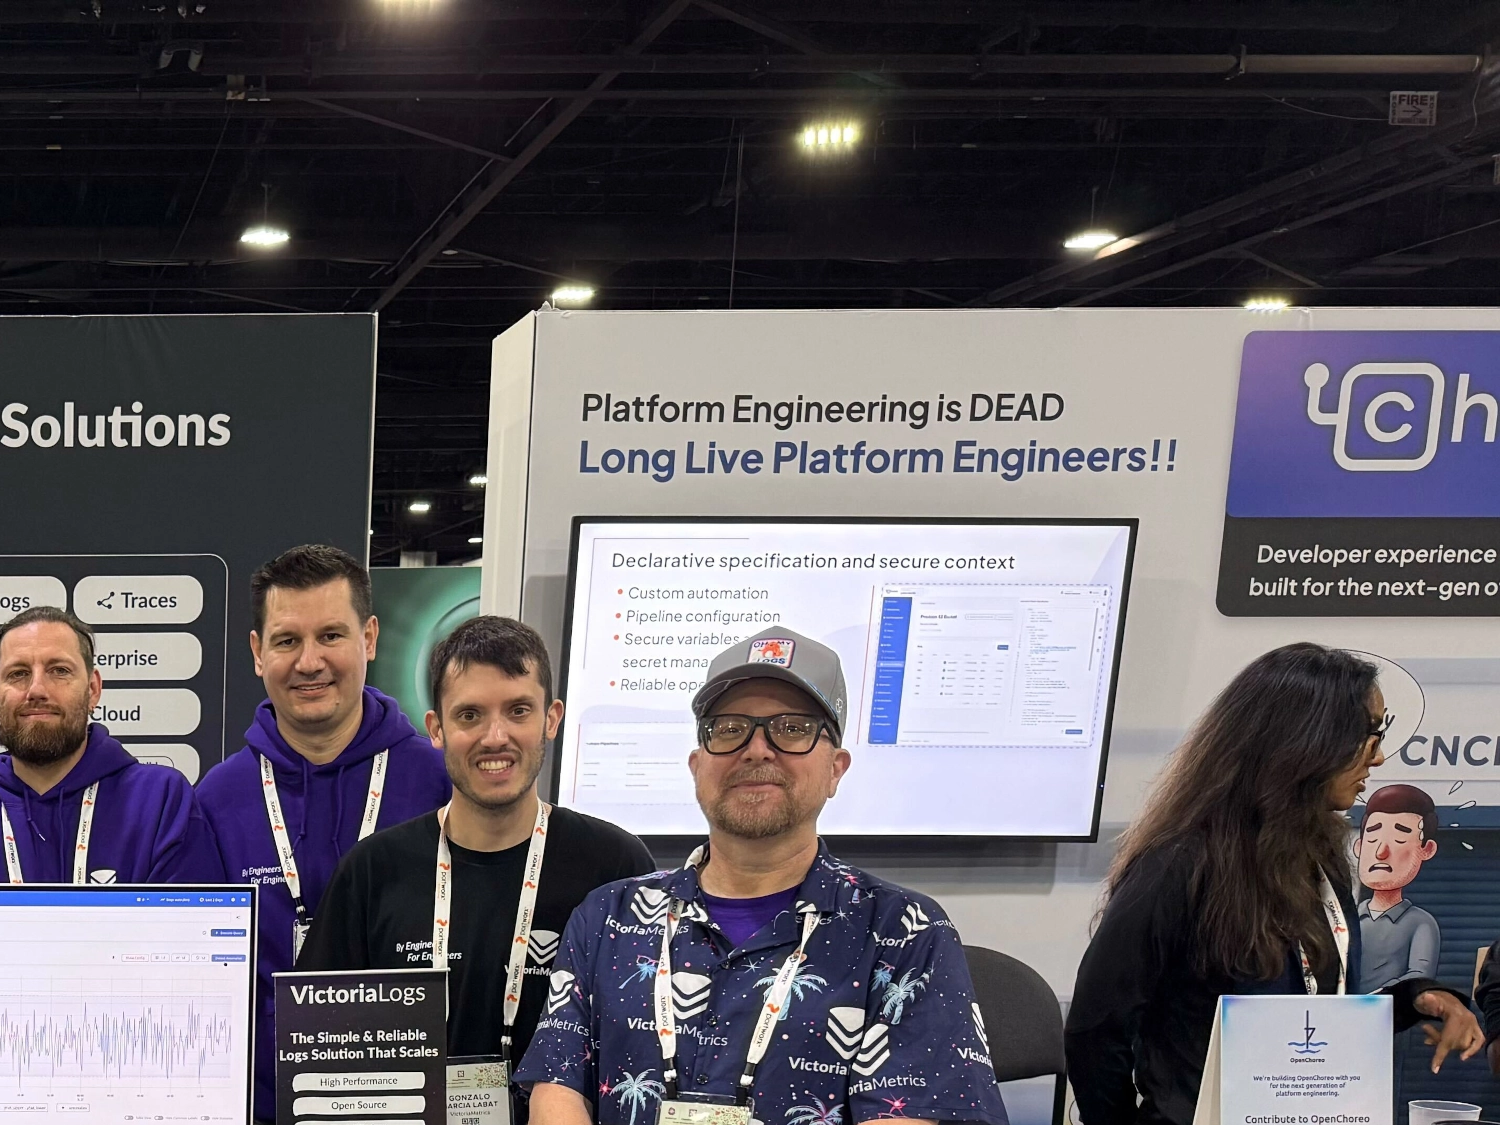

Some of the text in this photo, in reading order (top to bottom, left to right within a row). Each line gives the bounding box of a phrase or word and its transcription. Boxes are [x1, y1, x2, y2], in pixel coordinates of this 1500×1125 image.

[1398, 94, 1429, 106] FIRE
[582, 392, 1065, 430] Platform Engineering is DEAD
[0, 401, 231, 448] Solutions
[579, 438, 1177, 483] Long Live Platform Engineers!!
[612, 552, 1016, 571] Declarative specification and secure context
[1257, 544, 1498, 567] Developer experience
[628, 586, 769, 600] Custom automation
[1248, 577, 1298, 597] built
[1301, 577, 1335, 597] for
[1337, 577, 1374, 597] the
[120, 592, 177, 609] Traces
[626, 609, 781, 627] Pipeline configuration
[624, 632, 741, 646] Secure variables
[622, 657, 709, 669] secret mana
[620, 678, 676, 691] Reliable
[90, 704, 141, 722] Cloud
[249, 865, 282, 877] Engineers
[250, 876, 262, 886] For
[396, 942, 405, 953] By
[407, 952, 420, 963] For
[290, 982, 426, 1006] VictoriaLogs
[290, 1028, 428, 1046] The Simple & Reliable
[279, 1046, 439, 1063] Logs Solution That Scales
[320, 1075, 398, 1088] High Performance
[1296, 1074, 1335, 1082] OpenChoreo
[448, 1093, 491, 1102] GONZALO
[1275, 1090, 1340, 1098] platform engineering.
[331, 1099, 387, 1111] Open Source
[447, 1100, 499, 1109] ARCIA LABAT
[1245, 1114, 1370, 1125] Contribute to OpenChoreo
